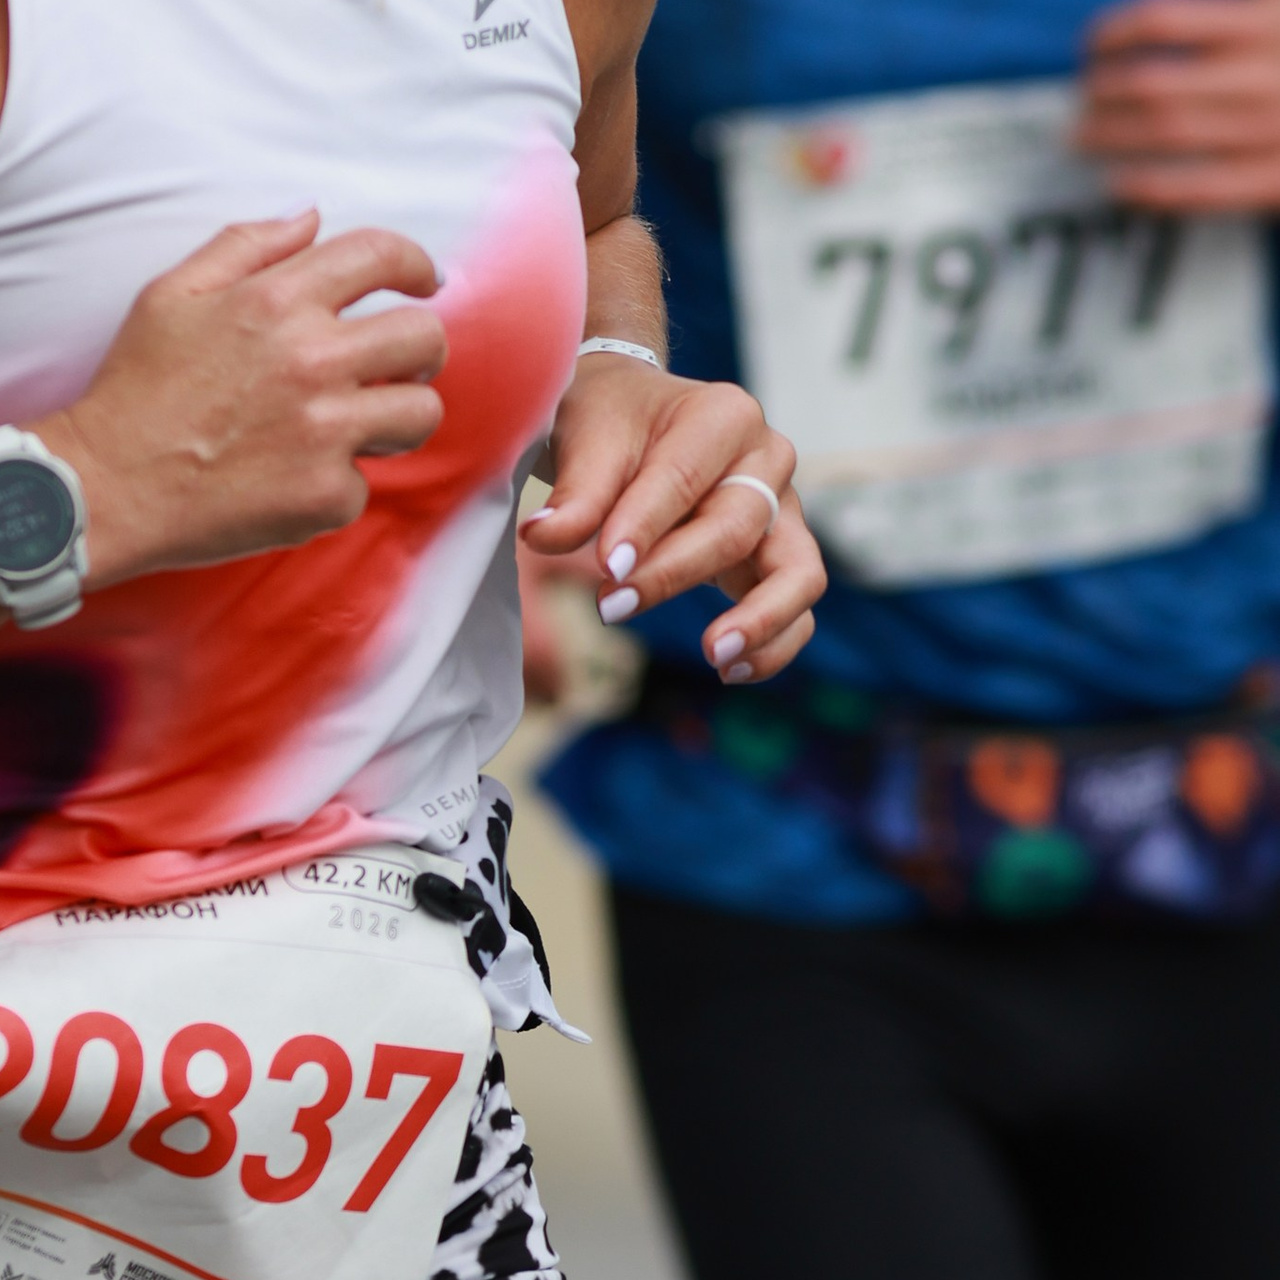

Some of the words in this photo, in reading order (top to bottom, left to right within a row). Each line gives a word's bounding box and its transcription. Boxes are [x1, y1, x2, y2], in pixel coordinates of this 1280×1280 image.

[462, 18, 531, 50] DEMIX
[814, 213, 1184, 370] 7977
[304, 862, 366, 889] 42,2
[54, 900, 219, 927] МАРАФОН
[328, 904, 400, 941] 2026
